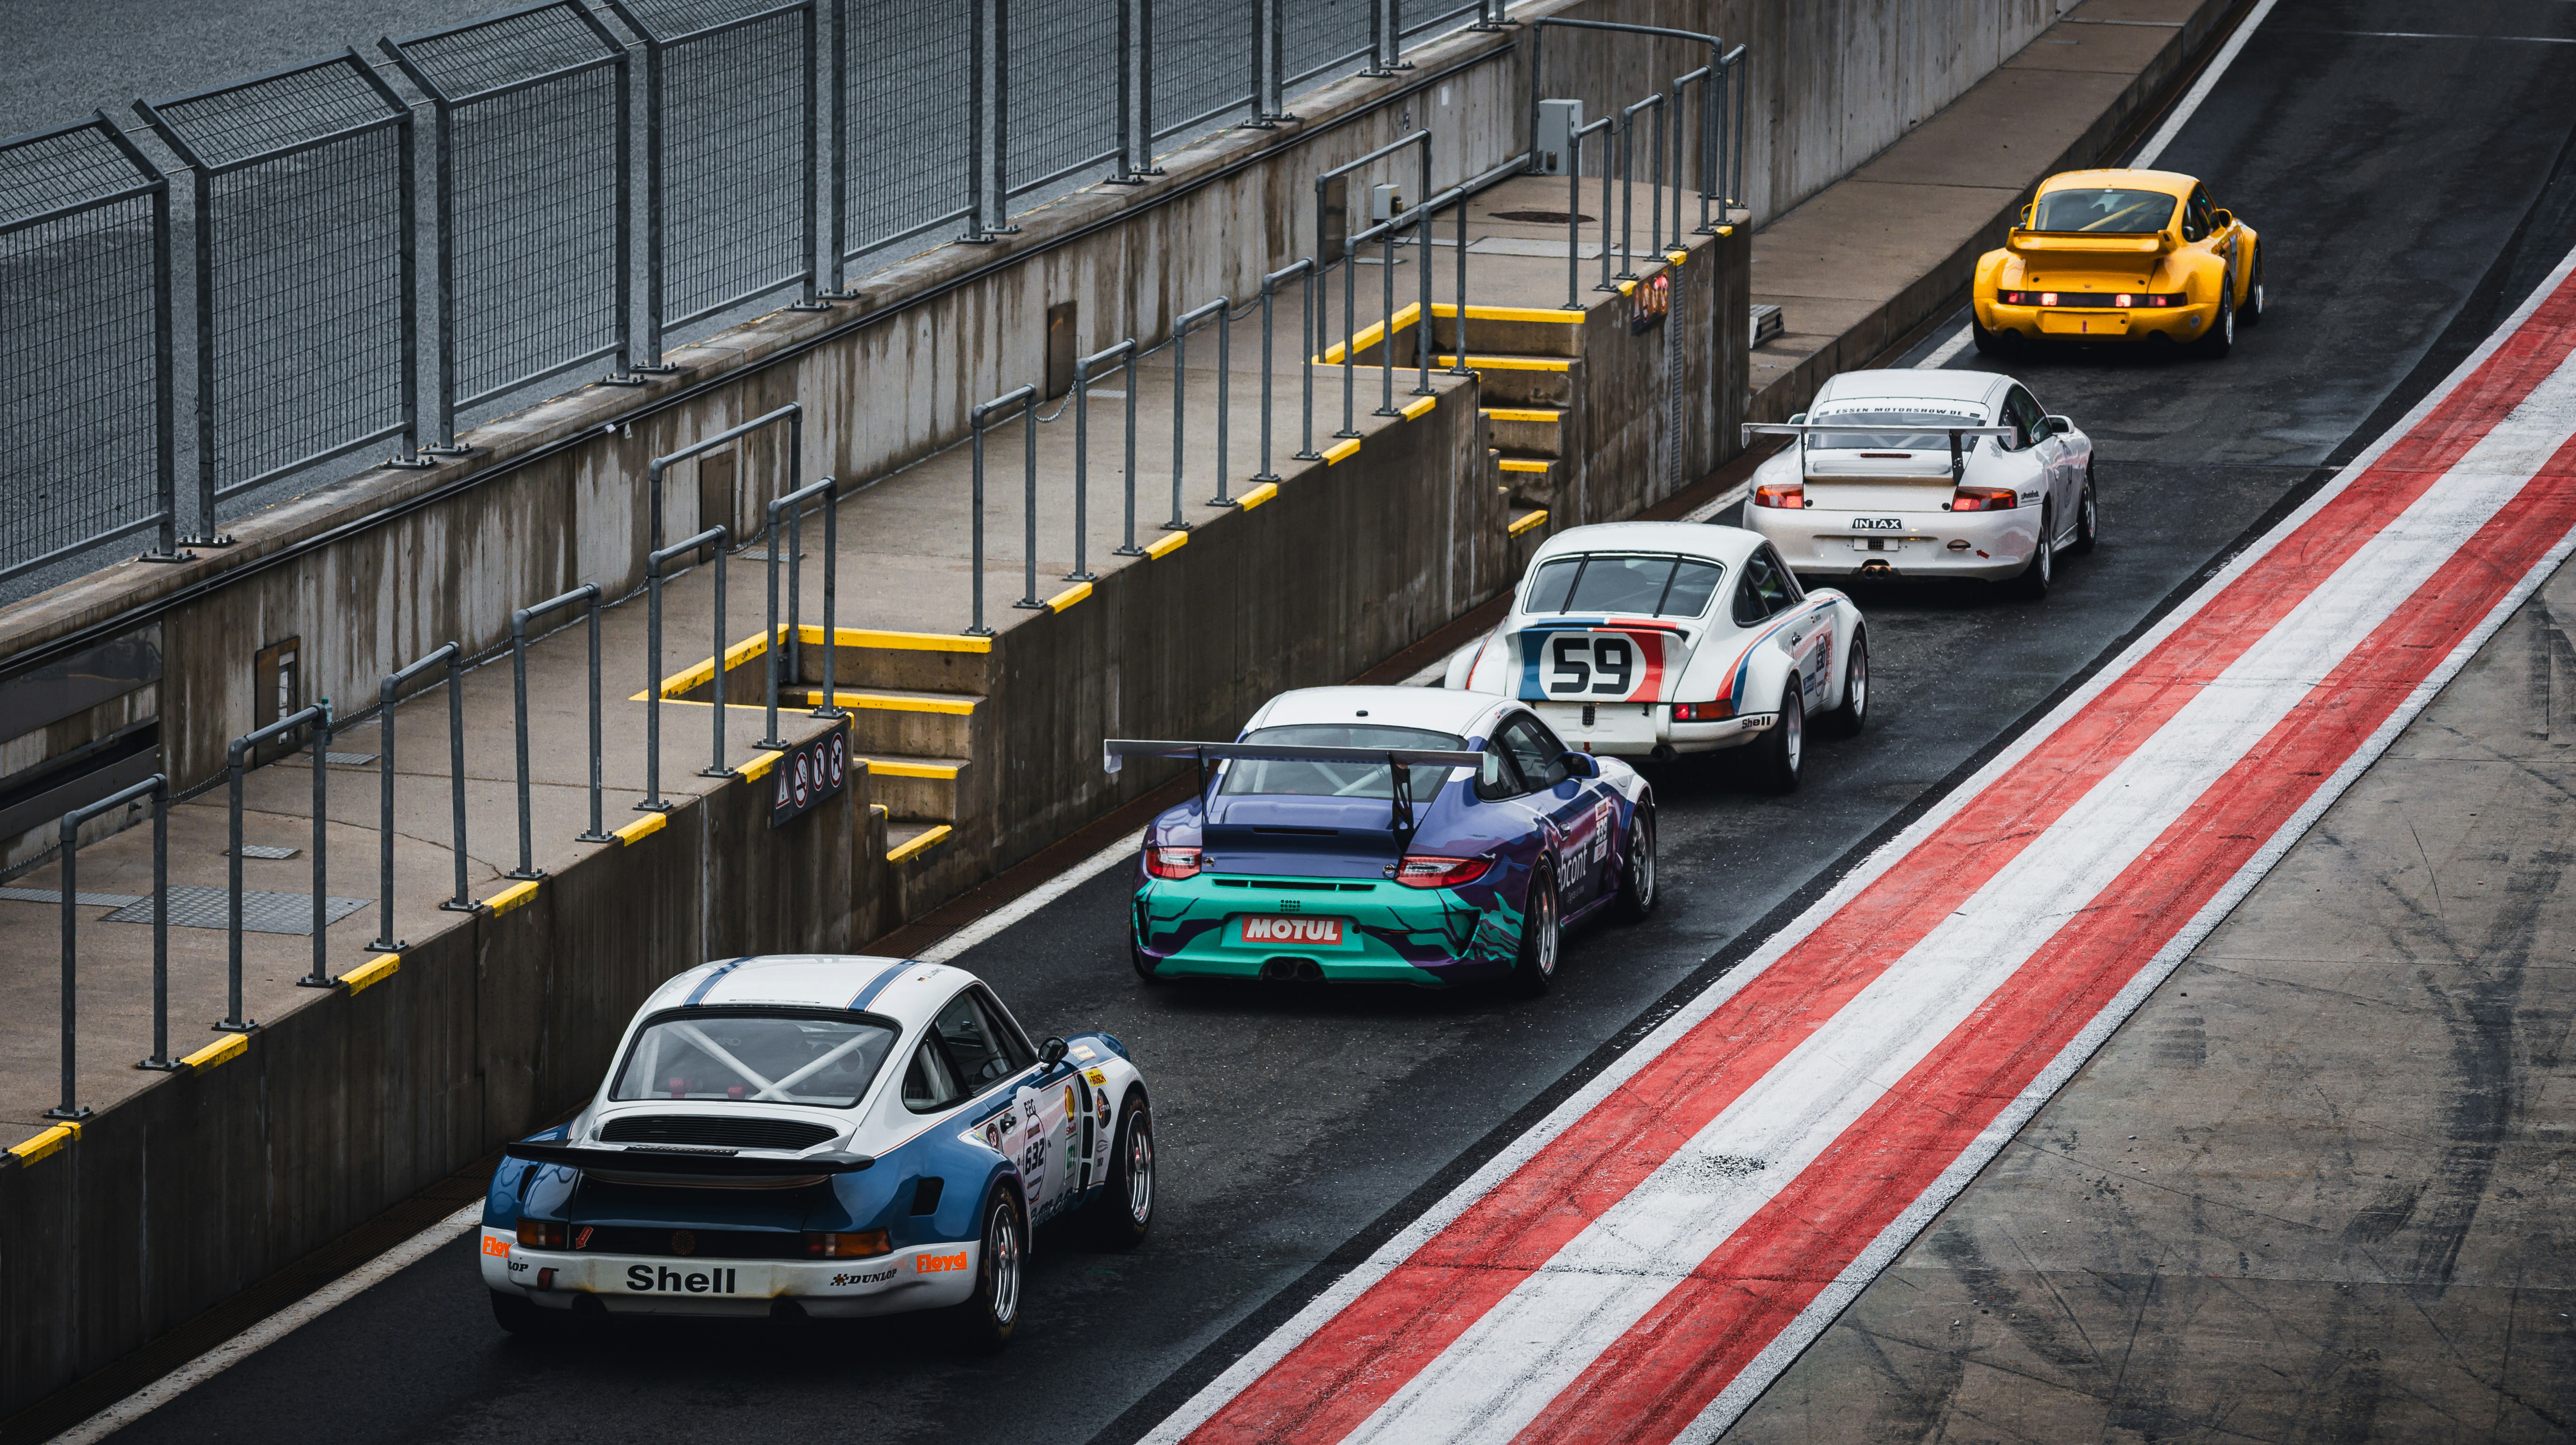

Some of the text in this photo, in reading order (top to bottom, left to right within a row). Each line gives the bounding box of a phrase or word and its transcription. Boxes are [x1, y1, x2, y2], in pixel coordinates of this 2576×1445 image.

[1855, 519, 1899, 528] INTAX
[1551, 638, 1632, 694] 59
[1742, 716, 1770, 729] Shell
[1246, 918, 1338, 941] MOTUL
[1091, 1073, 1106, 1085] BOSCH
[1066, 1122, 1076, 1135] Shell
[1025, 1137, 1045, 1176] 632
[482, 1236, 515, 1258] Floy
[508, 1260, 528, 1272] LOP
[917, 1251, 967, 1274] Floyd
[626, 1264, 736, 1294] Shell
[847, 1269, 897, 1284] DUNLOP
